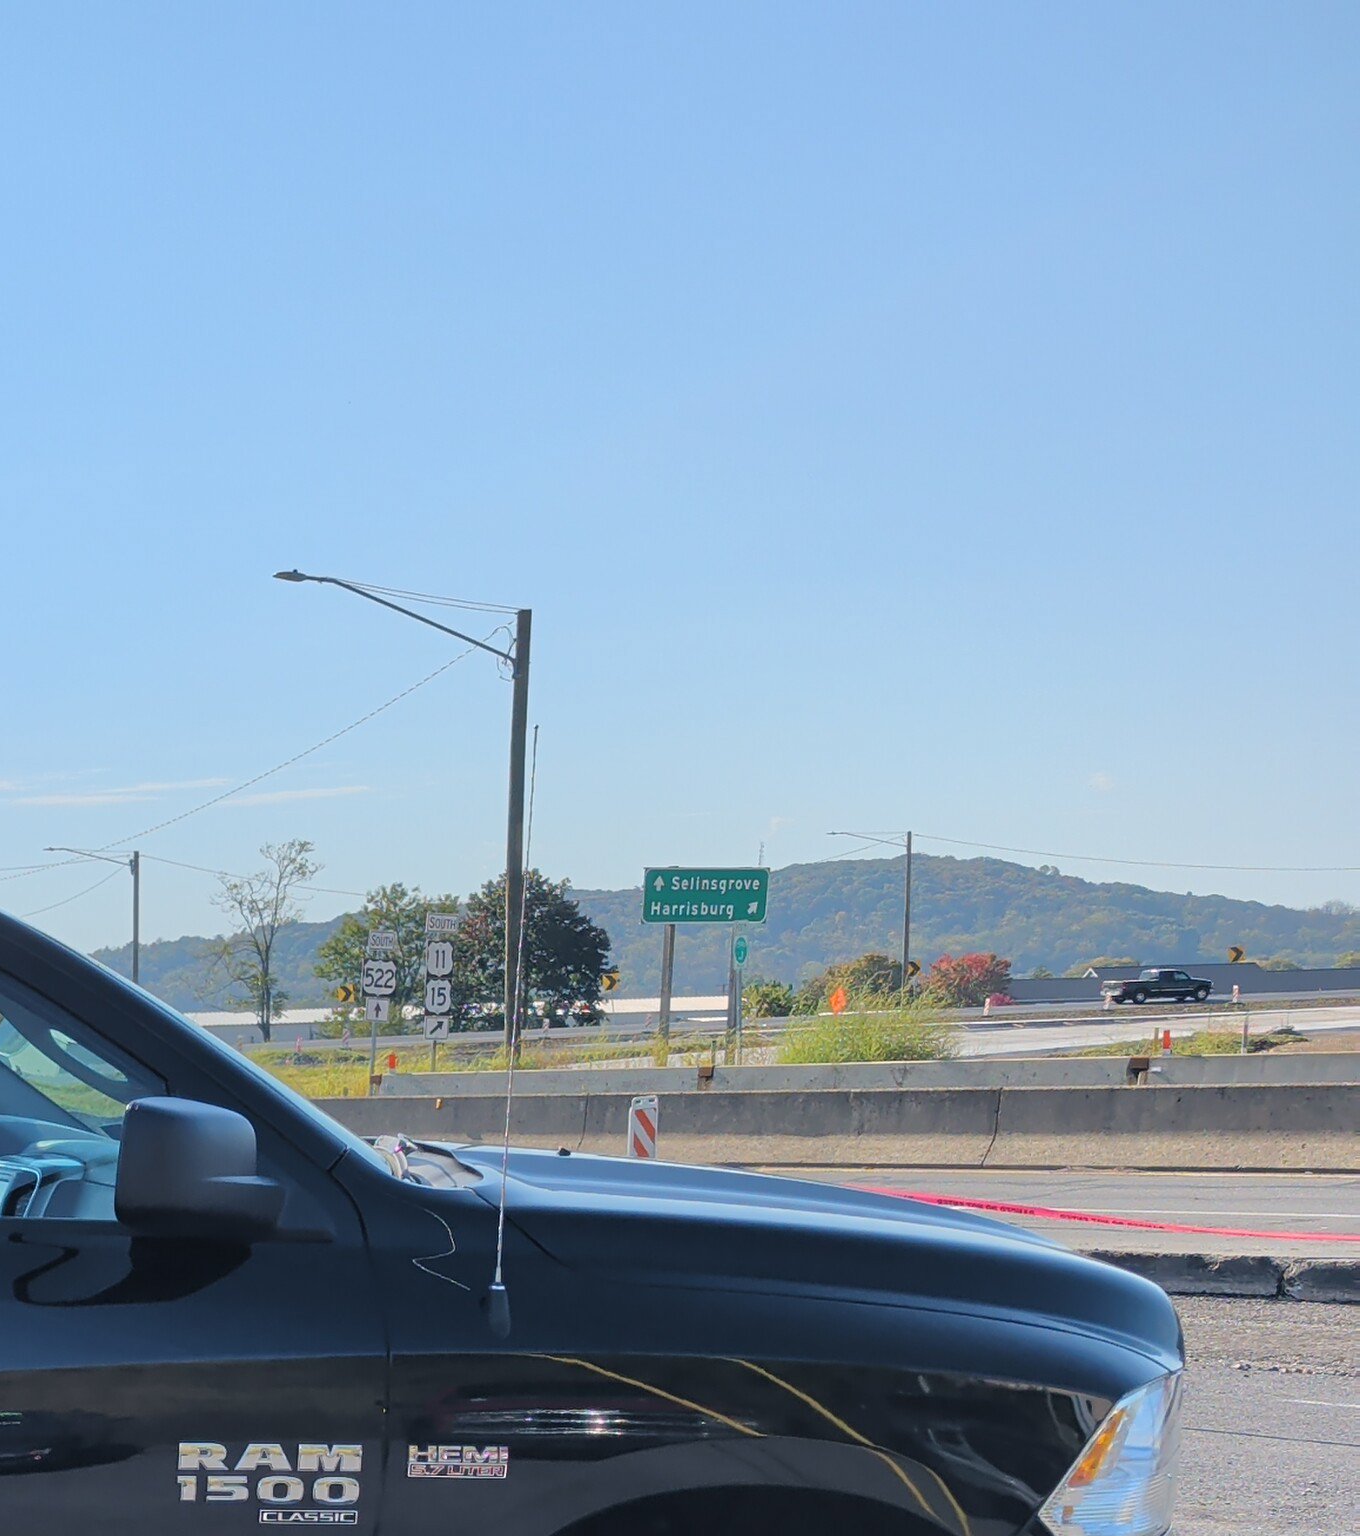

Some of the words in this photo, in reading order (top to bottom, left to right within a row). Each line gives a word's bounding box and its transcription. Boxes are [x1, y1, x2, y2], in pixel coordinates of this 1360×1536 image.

[671, 876, 760, 894] Selinsgrove
[650, 901, 734, 919] Harrisburg
[429, 916, 457, 930] SOUTH
[371, 934, 394, 947] SOUTH
[435, 949, 446, 969] 11
[364, 967, 395, 989] 522
[431, 986, 447, 1007] 15
[178, 1442, 363, 1472] RAM
[408, 1445, 509, 1463] HEMI
[411, 1464, 445, 1476] 5.7
[446, 1464, 504, 1477] LITER
[177, 1475, 360, 1505] 1500
[262, 1512, 356, 1522] CLASSIC
